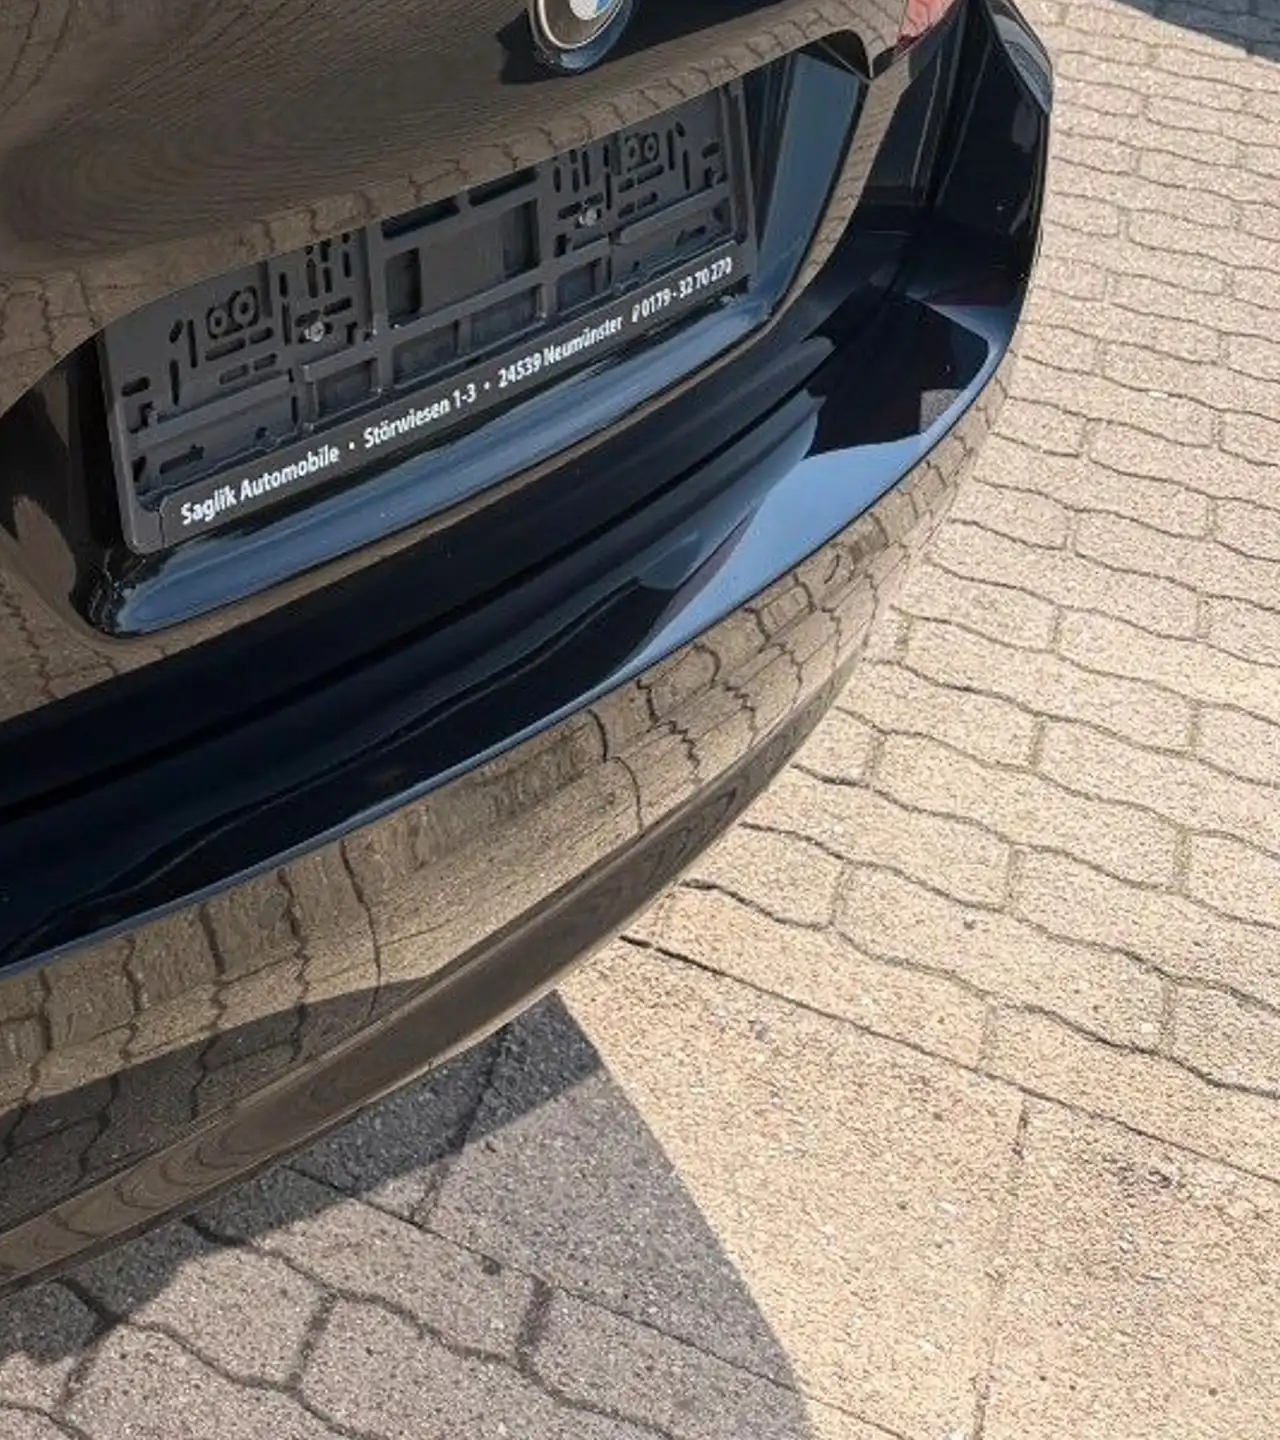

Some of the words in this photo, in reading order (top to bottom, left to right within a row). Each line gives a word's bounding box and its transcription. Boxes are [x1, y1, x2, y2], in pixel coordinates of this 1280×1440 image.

[180, 484, 237, 525] Saglik
[239, 443, 340, 502] Automobile
[363, 398, 451, 448] Störwiesen
[452, 382, 476, 409] 1-3
[497, 353, 542, 389] 24539
[543, 314, 623, 367] Neumünster
